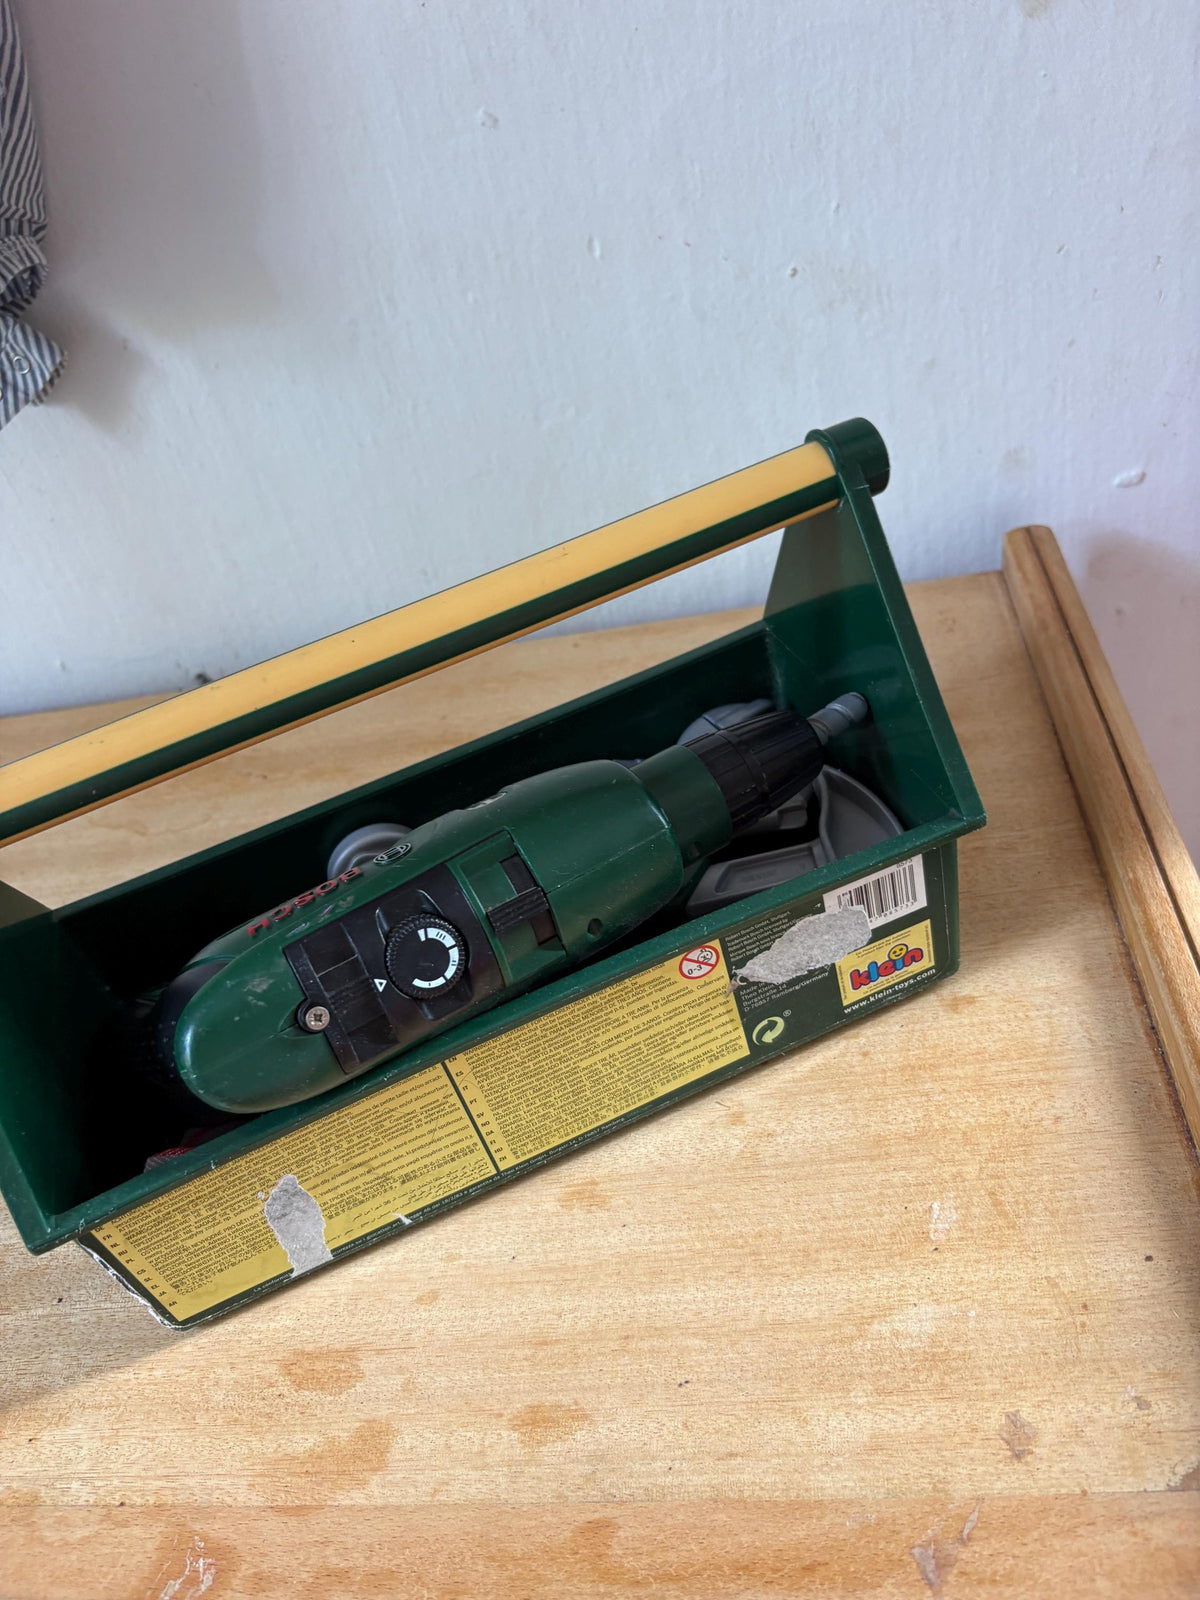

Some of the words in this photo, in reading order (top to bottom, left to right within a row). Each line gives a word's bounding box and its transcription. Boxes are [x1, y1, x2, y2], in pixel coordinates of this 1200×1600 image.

[687, 962, 703, 976] 0-3
[850, 944, 924, 991] klein
[844, 968, 936, 1014] www.klein-toys.com
